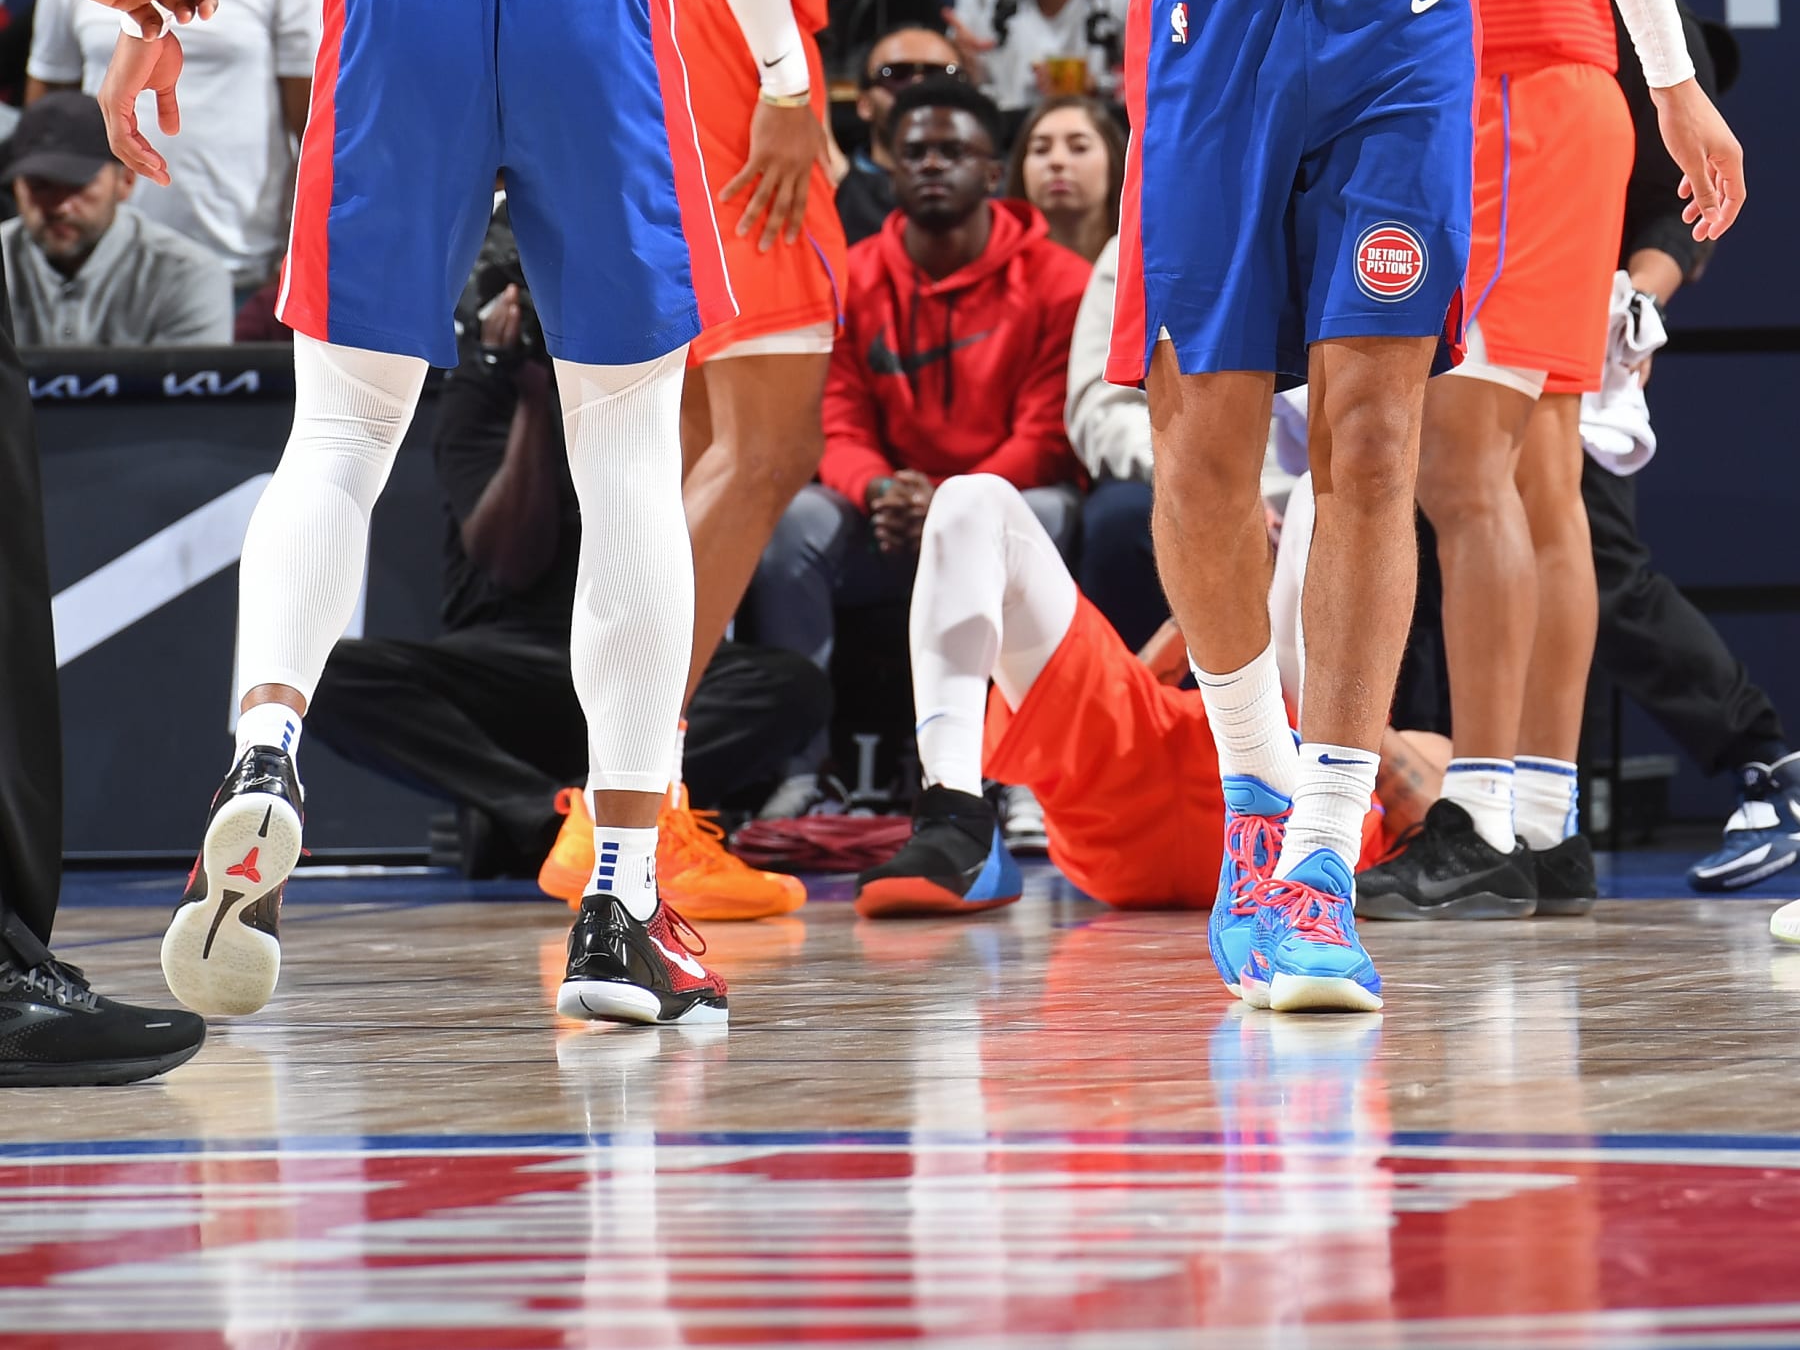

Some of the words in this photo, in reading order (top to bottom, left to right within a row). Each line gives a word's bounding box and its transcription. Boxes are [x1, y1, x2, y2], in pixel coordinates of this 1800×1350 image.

[1367, 247, 1413, 263] DETROIT
[1366, 260, 1412, 275] PISTONS
[162, 370, 260, 396] KIA
